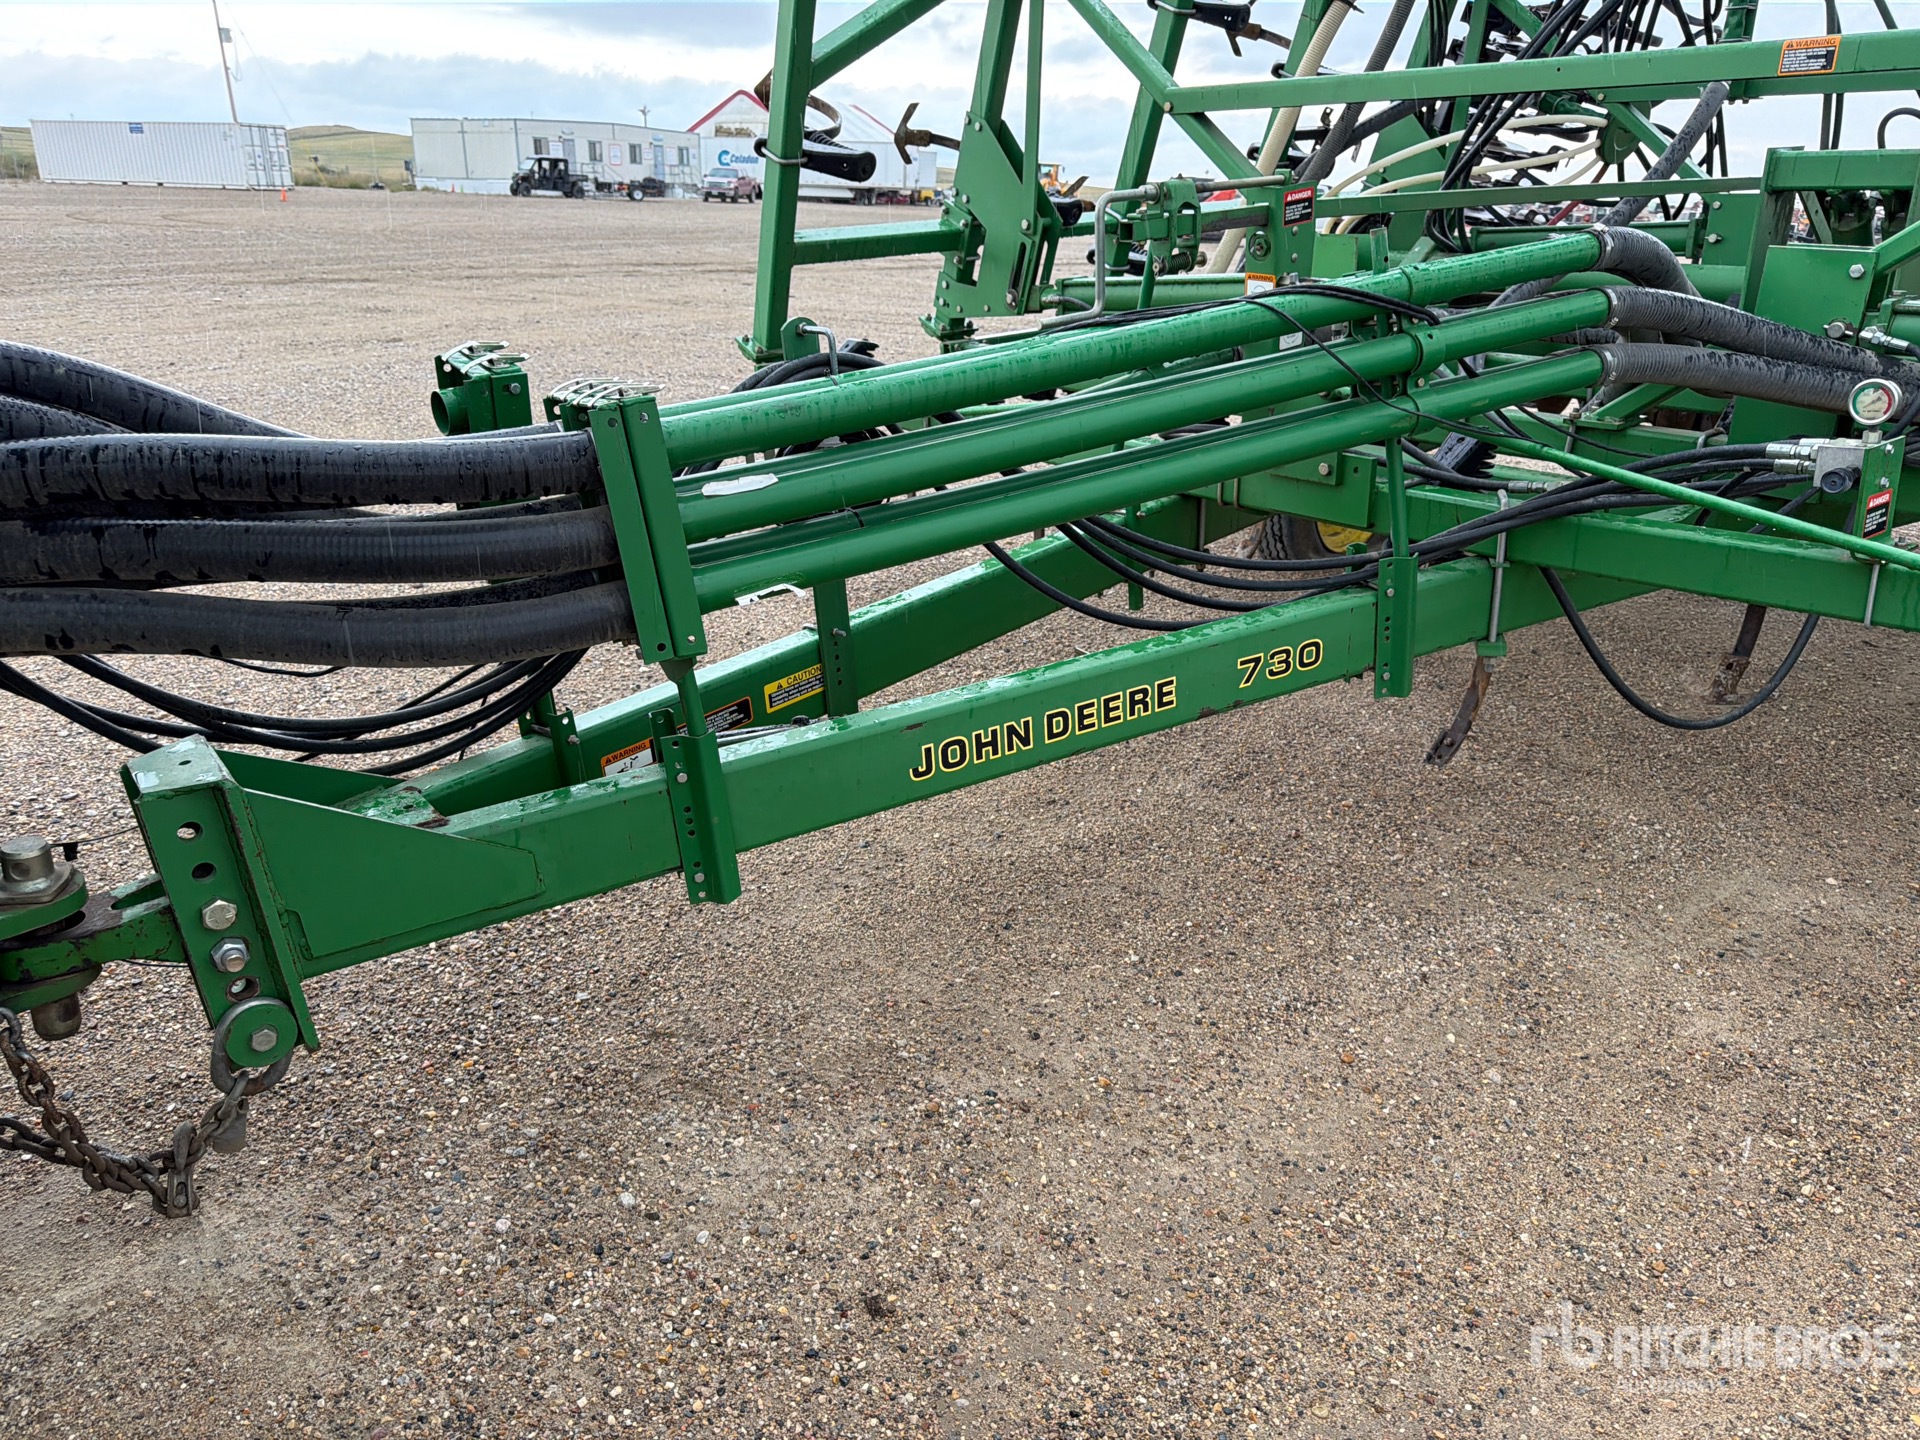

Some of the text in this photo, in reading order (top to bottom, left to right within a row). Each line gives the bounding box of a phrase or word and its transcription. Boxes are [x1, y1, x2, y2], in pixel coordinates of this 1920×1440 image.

[1796, 38, 1836, 47] WARNING
[731, 154, 759, 164] Celadon
[1291, 190, 1312, 200] DANGER
[1252, 274, 1274, 282] WARNING
[1872, 494, 1890, 507] DANGER
[1237, 638, 1324, 689] 730
[786, 664, 822, 686] CAUTION
[909, 676, 1177, 782] JOHN DEERE
[611, 742, 647, 761] WARNING
